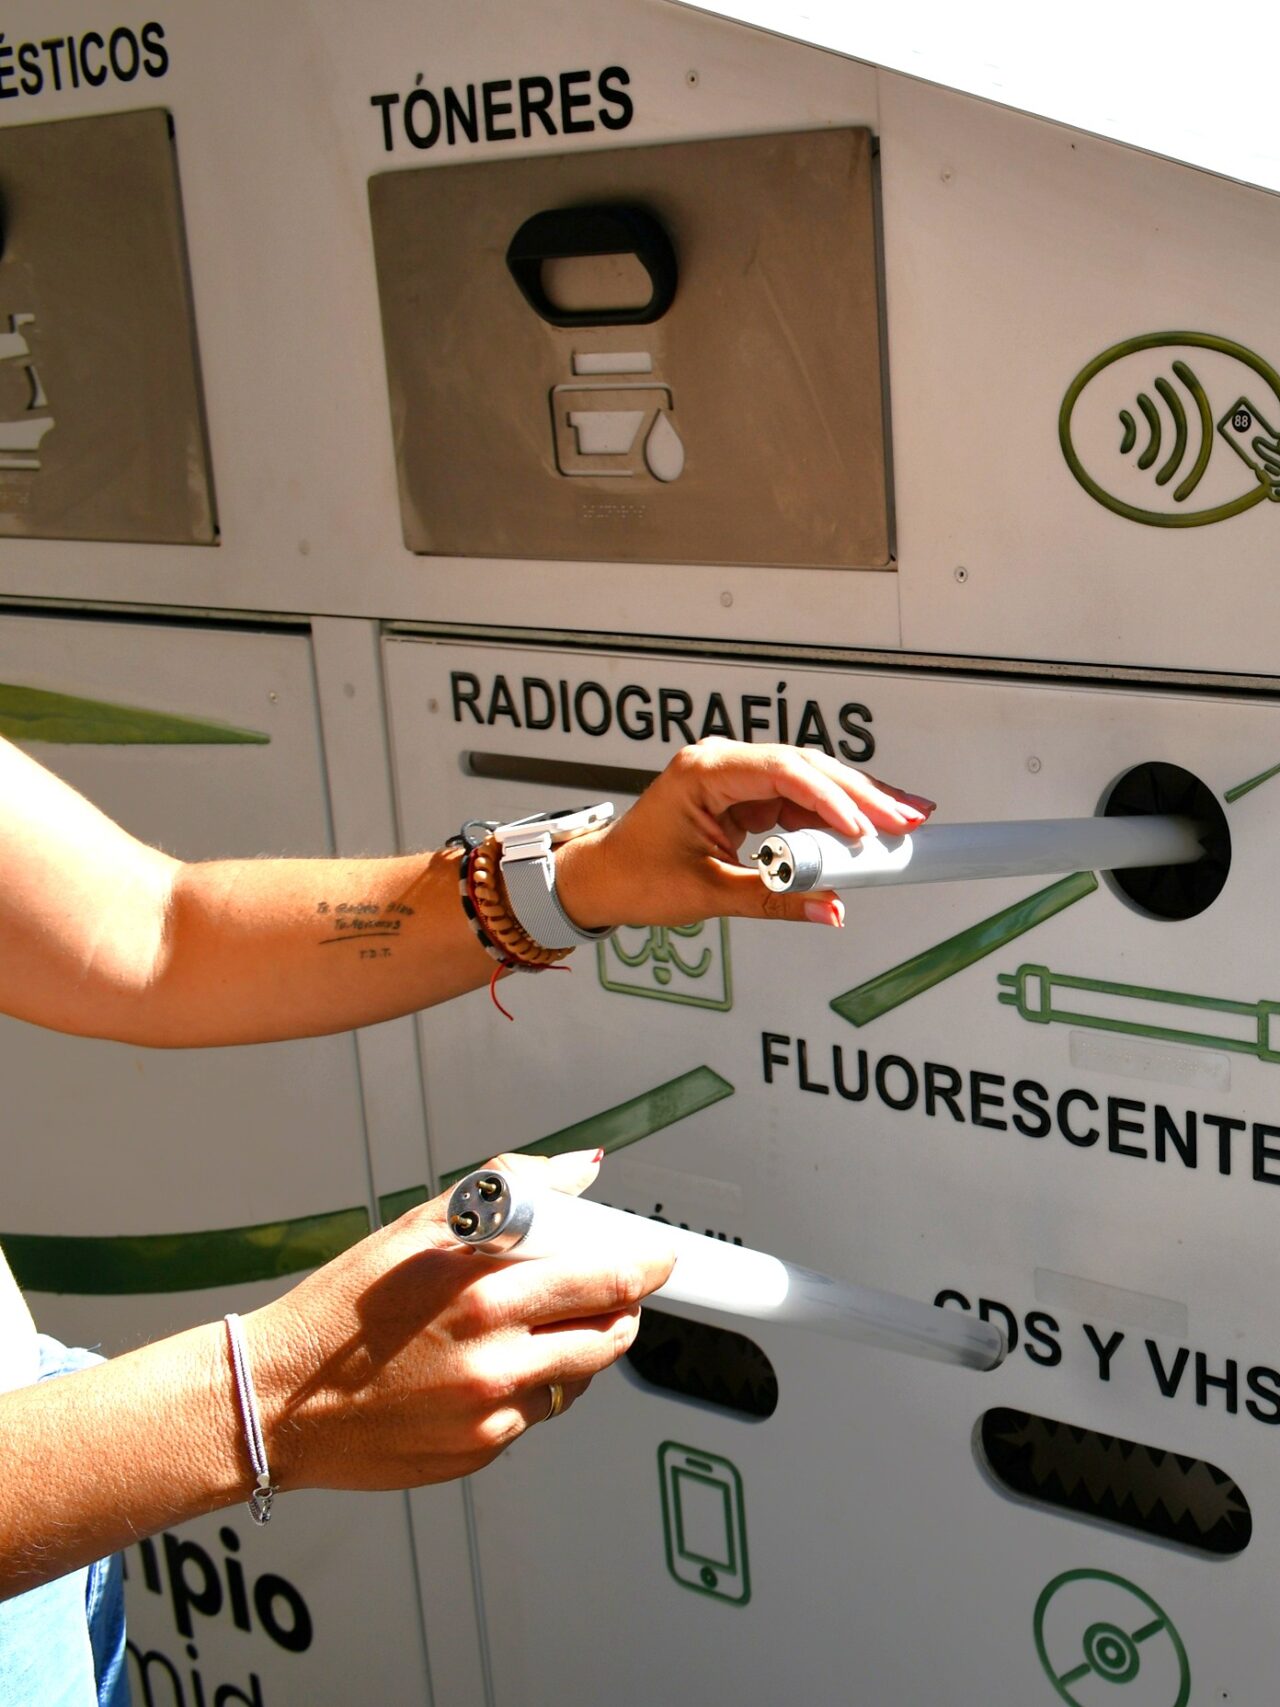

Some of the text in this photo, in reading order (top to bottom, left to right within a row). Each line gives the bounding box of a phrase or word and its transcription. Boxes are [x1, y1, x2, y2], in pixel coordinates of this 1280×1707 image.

[370, 65, 635, 152] TÓNERES
[450, 670, 876, 763] RADIOGRAFÍAS
[1081, 1322, 1126, 1383] Y
